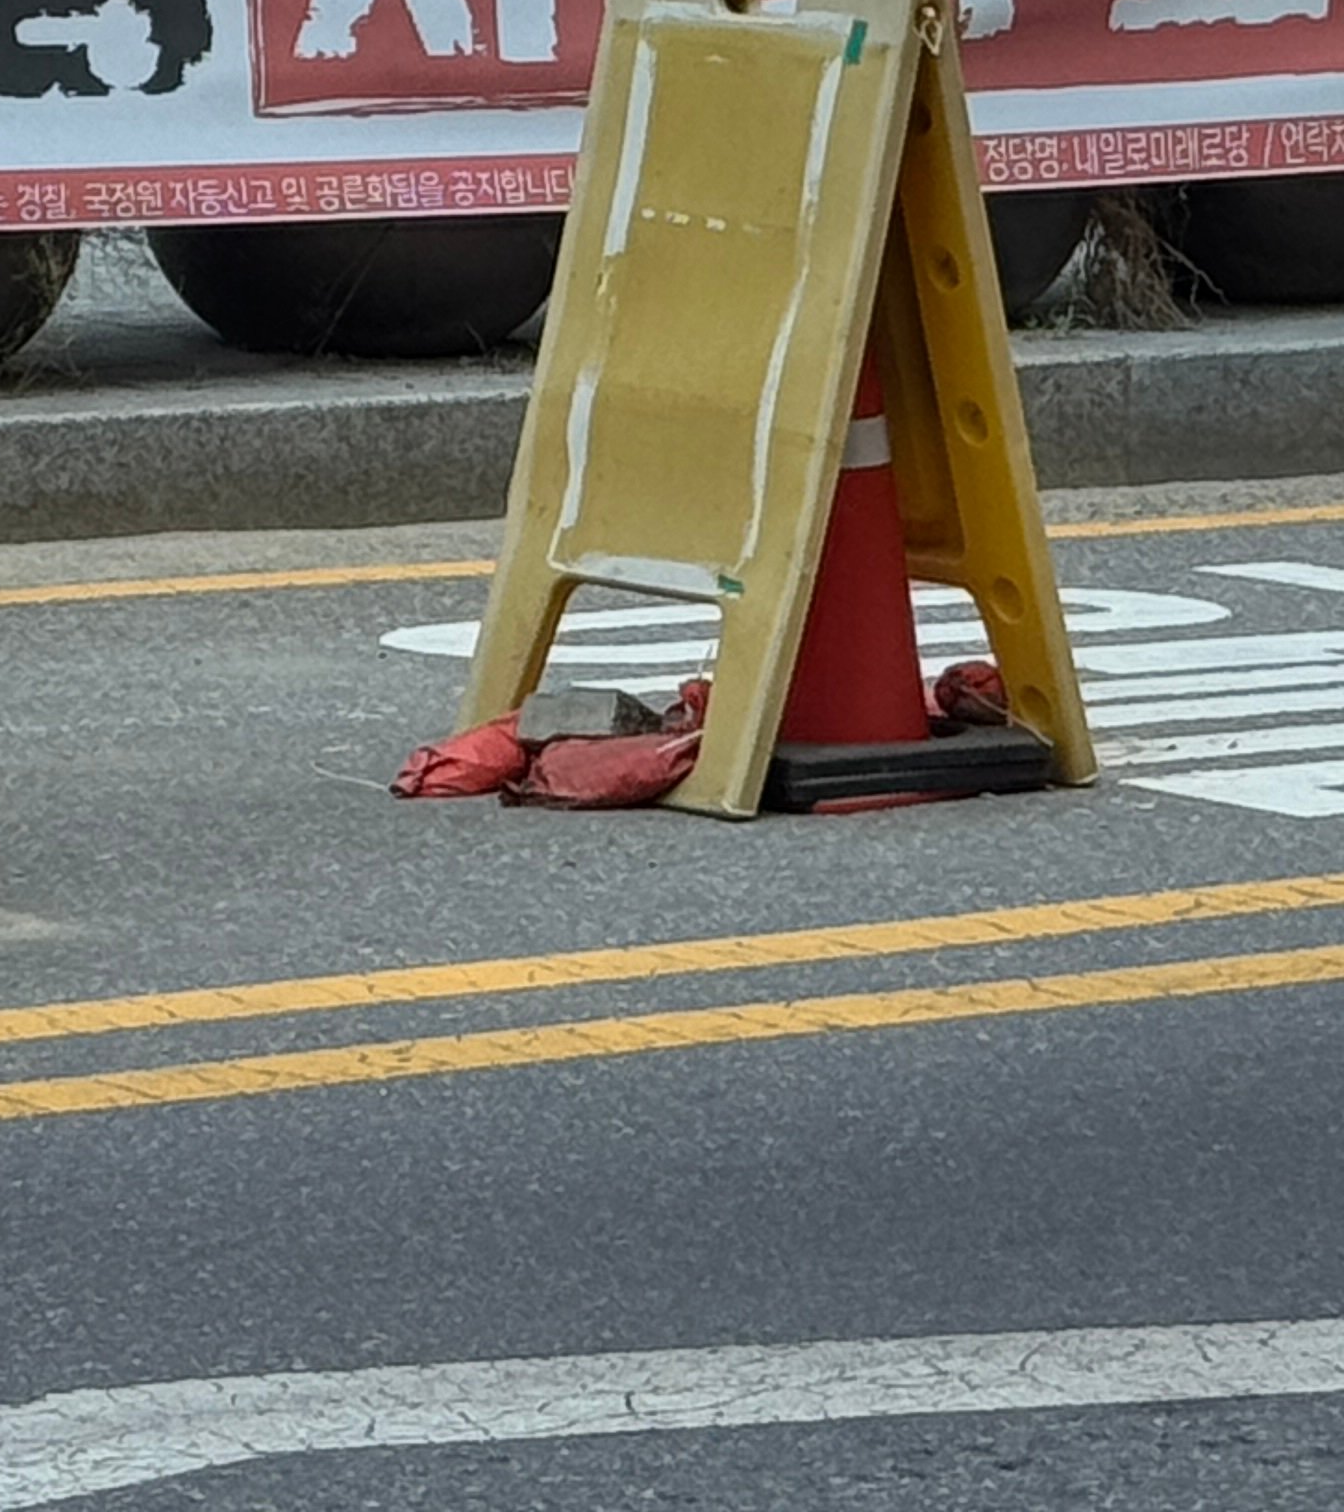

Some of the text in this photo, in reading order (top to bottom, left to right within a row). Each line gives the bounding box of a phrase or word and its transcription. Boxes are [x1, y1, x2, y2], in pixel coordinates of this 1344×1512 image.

[83, 179, 164, 219] 국정원
[170, 175, 277, 216] 자동신고
[281, 175, 310, 212] 및
